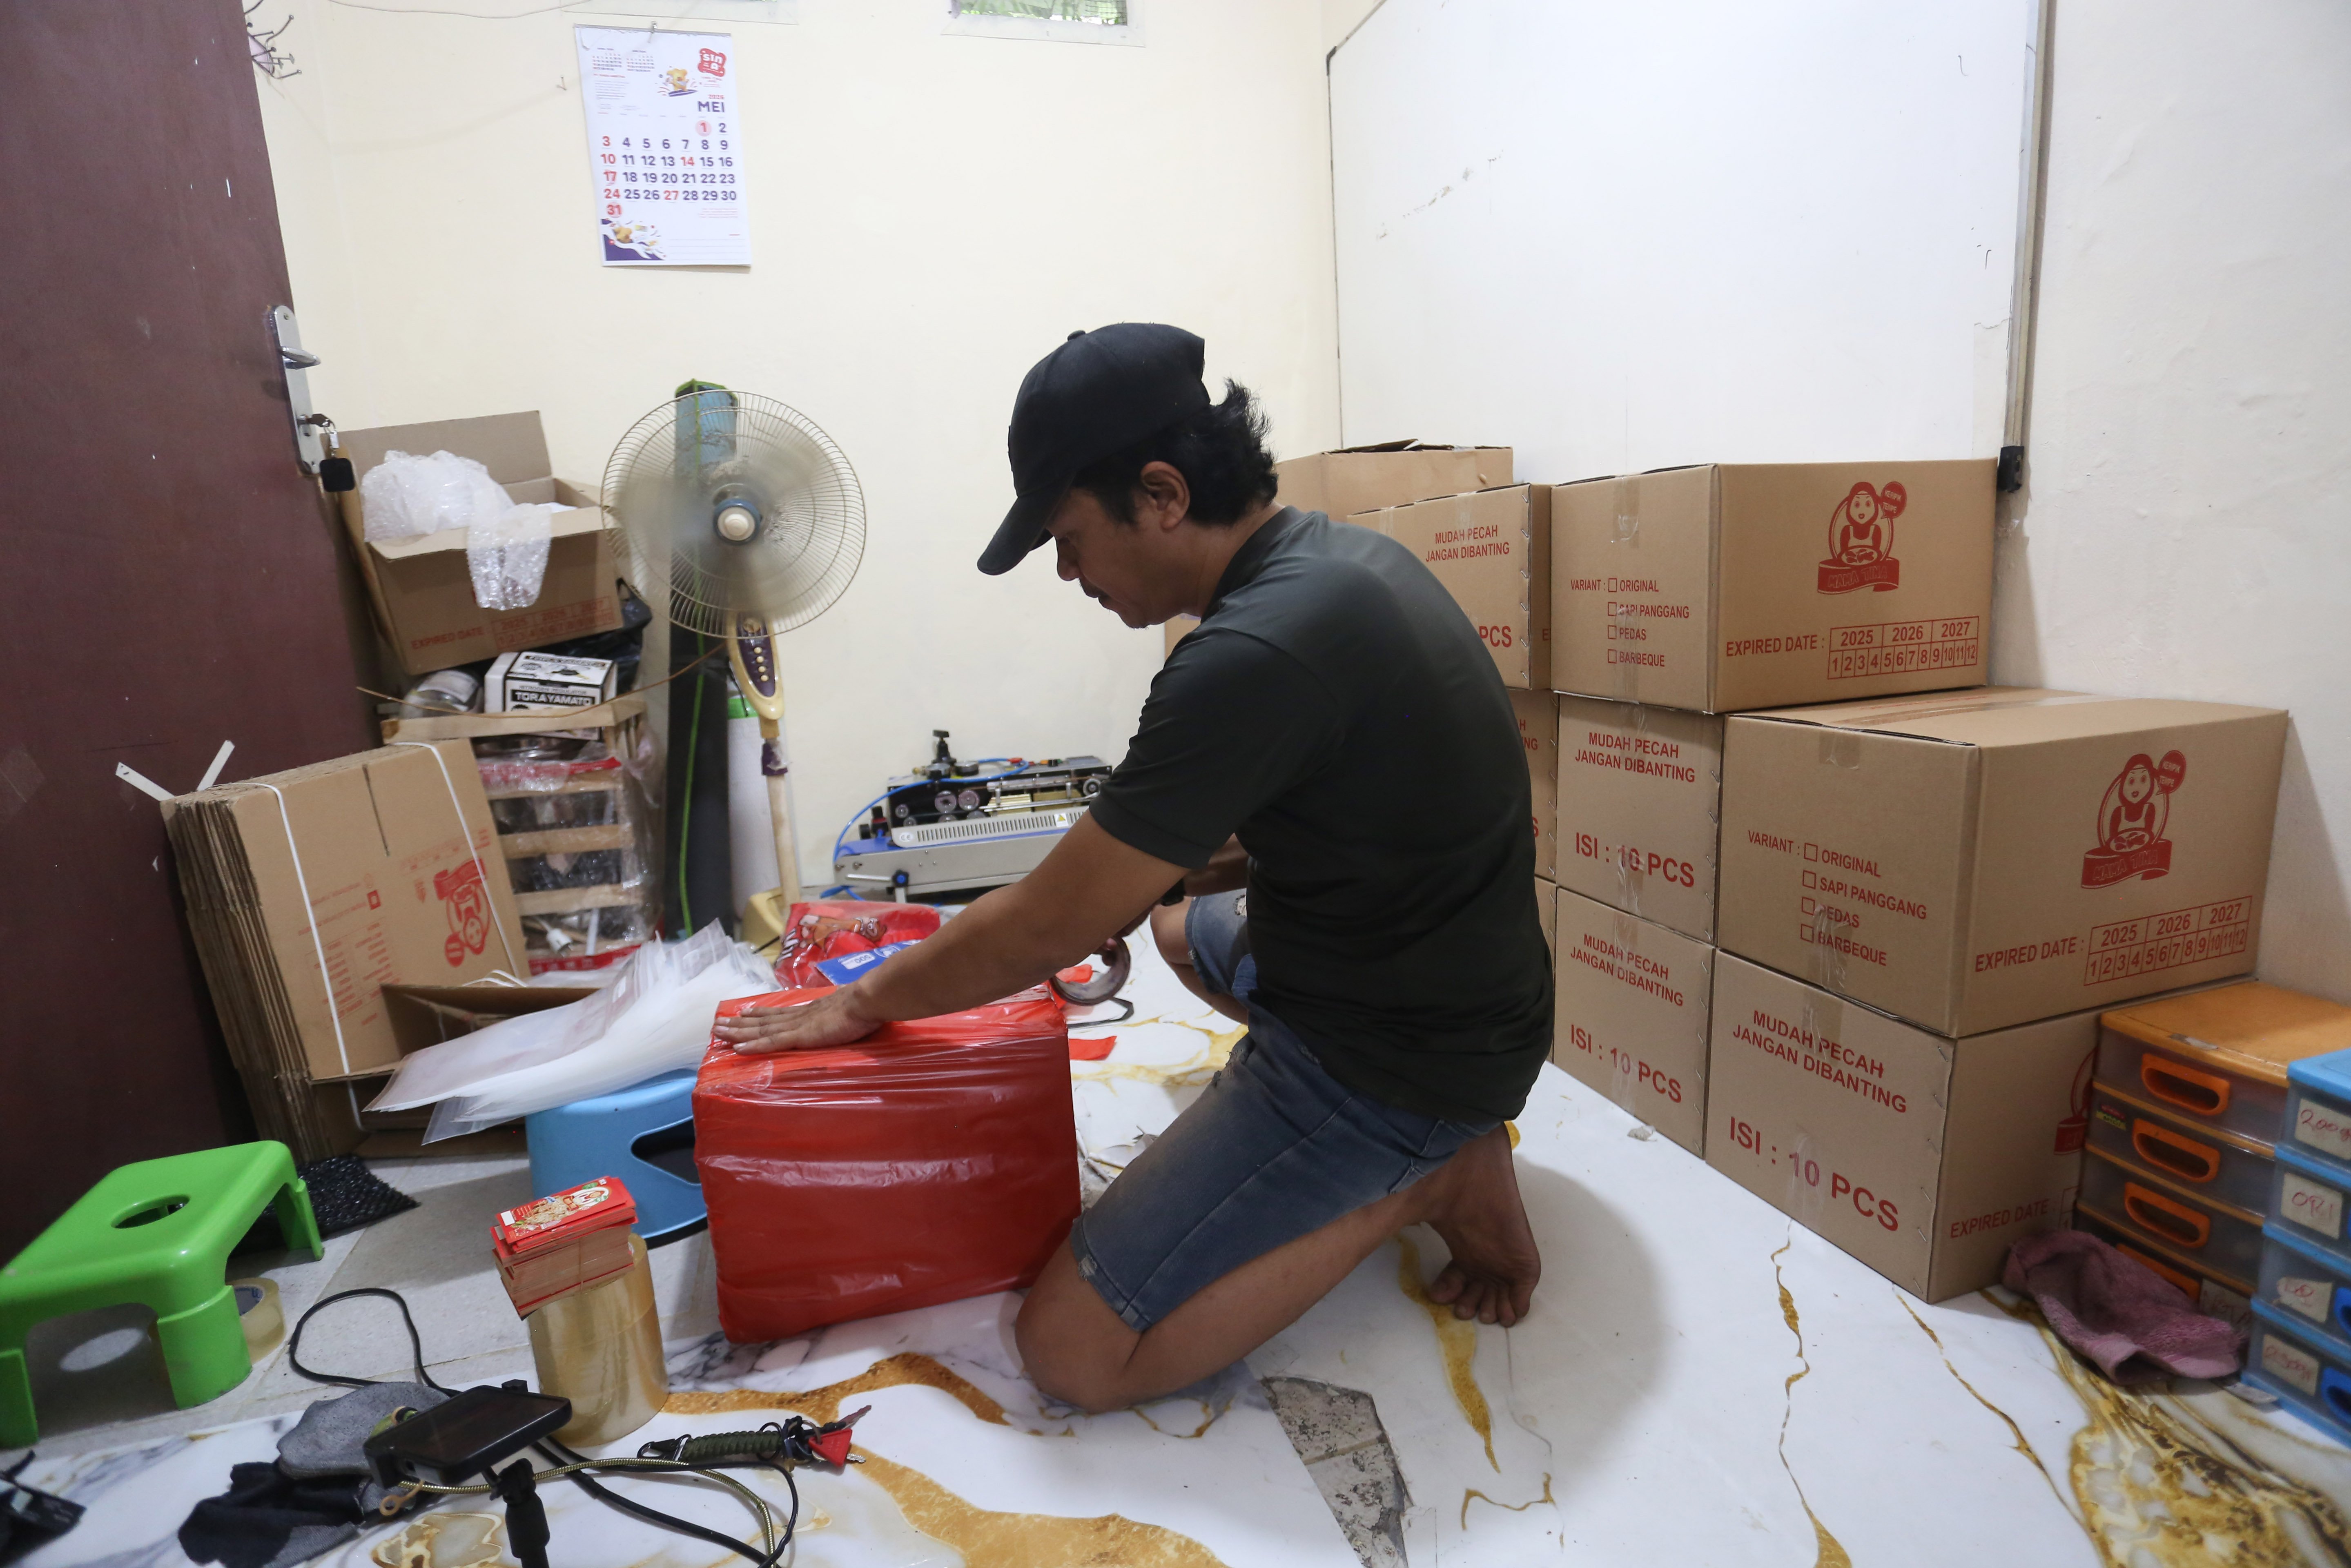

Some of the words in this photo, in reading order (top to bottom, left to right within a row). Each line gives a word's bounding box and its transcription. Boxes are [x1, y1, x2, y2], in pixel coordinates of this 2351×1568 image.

[698, 101, 725, 113] MEI
[700, 122, 706, 133] 1
[719, 123, 726, 133] 2
[603, 136, 610, 147] 3
[622, 138, 631, 147] 4
[643, 138, 651, 149] 5
[662, 139, 670, 149] 6
[682, 140, 689, 149] 7
[702, 140, 709, 150] 8
[720, 140, 728, 150] 9
[601, 154, 615, 164] 10
[622, 155, 635, 165] 11
[641, 156, 655, 166] 12
[661, 156, 675, 166] 13
[681, 157, 695, 167] 14
[700, 157, 714, 167] 15
[719, 157, 733, 167] 16
[604, 171, 617, 182] 17
[623, 172, 637, 183] 18
[642, 173, 657, 183] 19
[662, 174, 677, 184] 20
[682, 174, 696, 184] 21
[700, 174, 716, 184] 22
[719, 174, 735, 184] 23
[604, 189, 621, 199] 24
[624, 189, 640, 200] 25
[643, 189, 660, 200] 26
[664, 190, 679, 200] 27
[682, 191, 698, 200] 28
[702, 191, 718, 200] 29
[721, 191, 736, 200] 30
[607, 204, 622, 215] 31
[1883, 502, 1897, 513] TEMPE
[1435, 530, 1464, 543] MUDAH
[1468, 525, 1498, 540] PECAH
[1426, 549, 1458, 562] JANGAN
[1461, 542, 1509, 558] DIBANTING
[1571, 579, 1601, 591] VARIANT
[1620, 580, 1659, 592] ORIGINAL
[1827, 570, 1858, 588] MAMA
[1861, 566, 1887, 581] TINA
[1620, 604, 1637, 616] SAPI
[1640, 605, 1689, 619] PANGGANG
[1479, 626, 1512, 648] PCS
[1620, 627, 1646, 640] PEDAS
[1841, 630, 1874, 646] 2025
[1892, 626, 1923, 641] 2026
[1942, 621, 1970, 637] 2027
[1726, 638, 1781, 657] EXPIRED
[1786, 635, 1818, 650] DATE
[1832, 658, 1838, 672] 1
[1844, 656, 1852, 670] 2
[1857, 655, 1865, 669] 3
[1870, 654, 1879, 668] 4
[1883, 653, 1891, 667] 5
[1896, 652, 1903, 666] 6
[1908, 650, 1915, 664] 7
[1920, 649, 1928, 664] 8
[1932, 648, 1940, 662] 9
[1944, 646, 1953, 662] 10
[1956, 646, 1964, 660] 11
[1966, 644, 1976, 659] 12
[1620, 652, 1665, 667] BARBEQUE
[515, 692, 591, 706] TORAYAMATO
[1589, 732, 1631, 751] MUDAH
[1635, 739, 1679, 758] PECAH
[1575, 749, 1621, 769] JANGAN
[1625, 757, 1695, 783] DIBANTING
[1576, 832, 1598, 859] ISI
[1618, 845, 1640, 871] 10
[1648, 852, 1694, 888] PCS
[1748, 830, 1794, 853] VARIANT
[1822, 849, 1881, 878] ORIGINAL
[1820, 878, 1847, 897] SAPI
[1851, 886, 1927, 920] PANGGANG
[1819, 904, 1859, 928] PEDAS
[2101, 924, 2137, 947] 2025
[2156, 913, 2191, 935] 2026
[2209, 903, 2242, 924] 2027
[1584, 934, 1623, 961] MUDAH
[1627, 952, 1668, 980] PECAH
[1818, 931, 1887, 966] BARBEQUE
[1975, 945, 2037, 973] EXPIRED
[2041, 936, 2077, 959] DATE
[2090, 960, 2097, 976] 1
[2102, 957, 2111, 974] 2
[2117, 954, 2125, 971] 3
[2130, 952, 2140, 967] 4
[2145, 948, 2154, 965] 5
[2159, 946, 2167, 962] 6
[2172, 943, 2180, 959] 7
[2185, 940, 2193, 956] 8
[2198, 937, 2206, 953] 9
[2211, 935, 2221, 951] 10
[2224, 932, 2232, 948] 11
[2235, 929, 2245, 946] 12
[1571, 947, 1613, 976] JANGAN
[1618, 967, 1683, 1007] DIBANTING
[1753, 1010, 1813, 1048] MUDAH
[1819, 1038, 1884, 1078] PECAH
[1571, 1025, 1591, 1054] ISI
[1610, 1047, 1631, 1075] 10
[1638, 1060, 1681, 1103] PCS
[1733, 1025, 1798, 1065] JANGAN
[1804, 1054, 1906, 1113] DIBANTING
[1730, 1116, 1760, 1155] ISI
[1789, 1152, 1820, 1187] 10
[1831, 1172, 1898, 1232] PCS
[1950, 1209, 2010, 1238] EXPIRED
[2015, 1199, 2049, 1222] DATE
